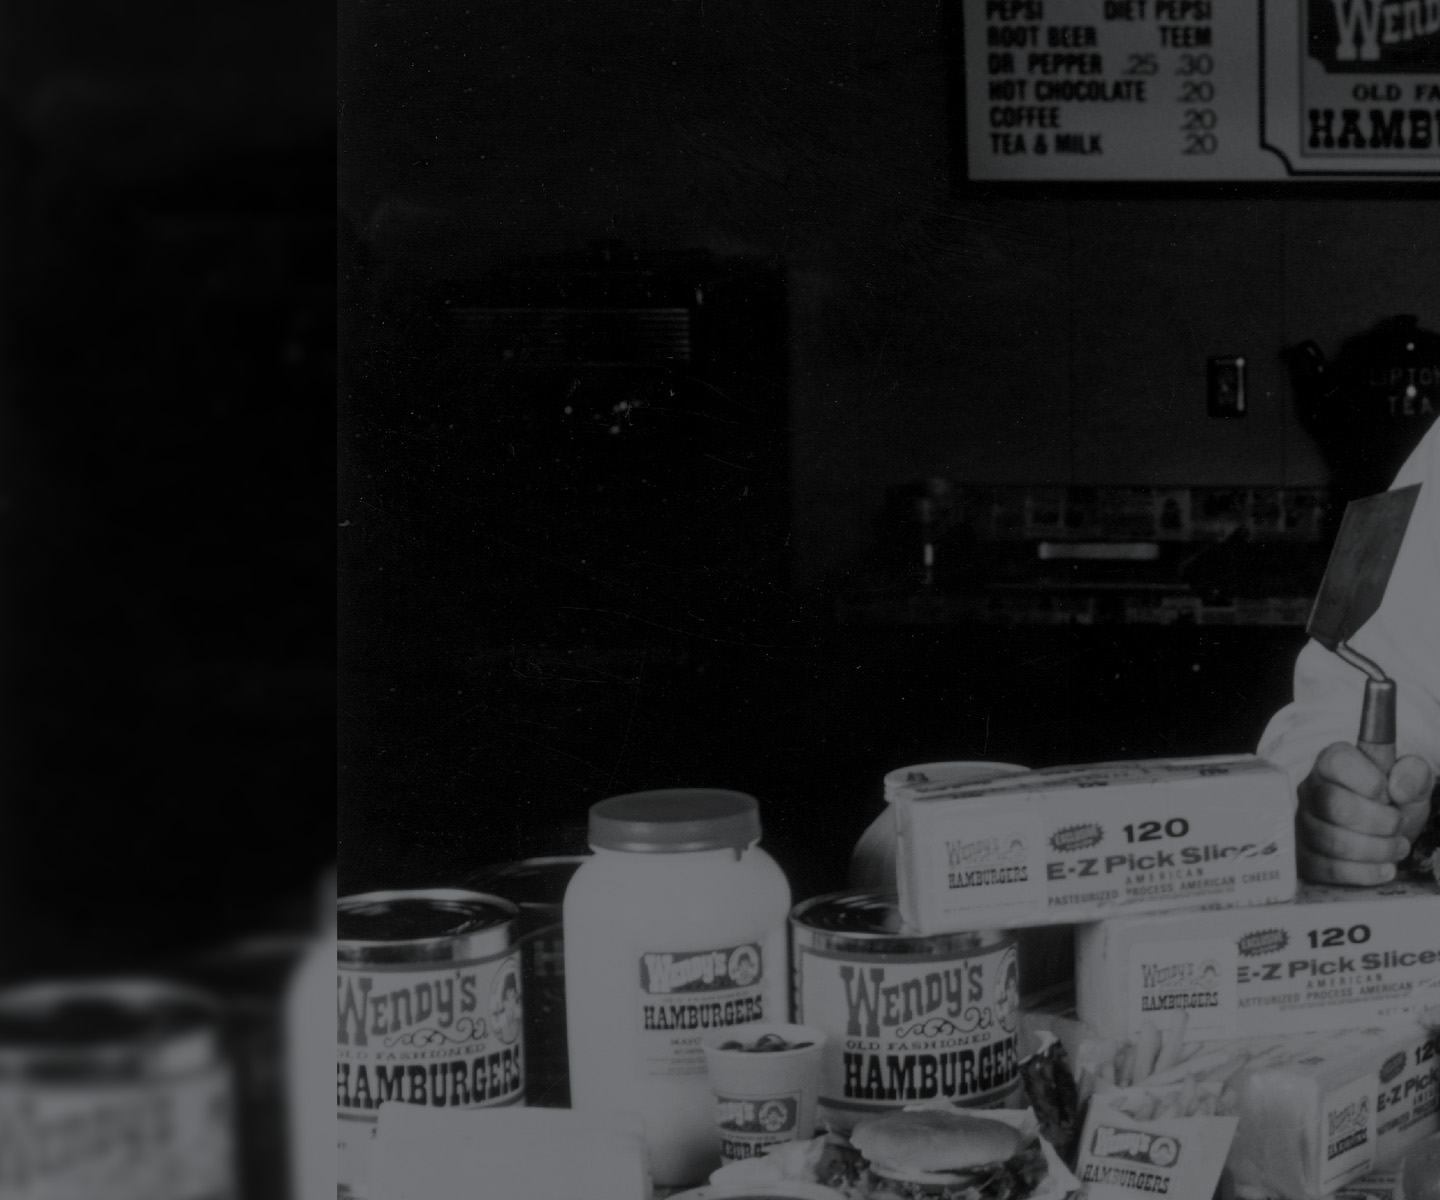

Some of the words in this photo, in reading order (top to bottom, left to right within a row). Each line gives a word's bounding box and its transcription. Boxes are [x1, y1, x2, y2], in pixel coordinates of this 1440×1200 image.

[986, 0, 1043, 21] PEPSI
[1104, 0, 1145, 21] DIET
[1155, 0, 1212, 21] PEPSI
[987, 26, 1039, 47] ROOT
[1048, 26, 1097, 47] BEER
[1159, 26, 1212, 47] TEEM
[988, 53, 1014, 75] DR
[1028, 53, 1102, 75] PEPPER
[1123, 53, 1159, 76] .25
[1174, 53, 1214, 76] .30
[988, 80, 1027, 101] HOT
[1035, 80, 1146, 102] CHOCOLATE
[1177, 80, 1215, 102] .20
[1353, 84, 1401, 101] OLD
[989, 106, 1060, 129] COFFEE
[1180, 107, 1217, 130] .20
[991, 133, 1026, 155] TEA
[1033, 134, 1049, 155] &
[1055, 133, 1104, 155] MILK
[1180, 131, 1218, 155] .20
[1388, 395, 1434, 415] TEA
[1122, 817, 1191, 844] 120
[947, 865, 1029, 890] HAMBURGERS
[1046, 859, 1099, 882] E-Z
[1105, 850, 1176, 875] Pick
[1125, 867, 1205, 886] AMERICAN
[1049, 889, 1120, 907] PASTEURIZED
[1125, 882, 1174, 897] PROCESS
[1180, 874, 1236, 892] AMERICAN
[1242, 869, 1281, 885] CHEESE
[1306, 923, 1372, 949] 120
[1236, 962, 1282, 984] E-Z
[1288, 956, 1356, 979] Pick
[1306, 972, 1383, 990] AMERICAN
[839, 960, 983, 1038] Wendy's
[1141, 992, 1219, 1012] HAMBURGERS
[1237, 992, 1301, 1008] ASTEURIZED
[1306, 987, 1353, 1002] PROCESS
[1359, 981, 1413, 996] AMERICAN
[337, 970, 477, 1046] Wendy's
[643, 993, 763, 1030] HAMBURGERS
[376, 1042, 486, 1061] FASHIONED
[846, 1039, 881, 1051] OLD
[888, 1031, 992, 1051] FASHIONED
[337, 1043, 520, 1110] HAMBURGERS
[1377, 1084, 1402, 1113] E-Z
[1082, 1163, 1171, 1195] HAMBURGERS
